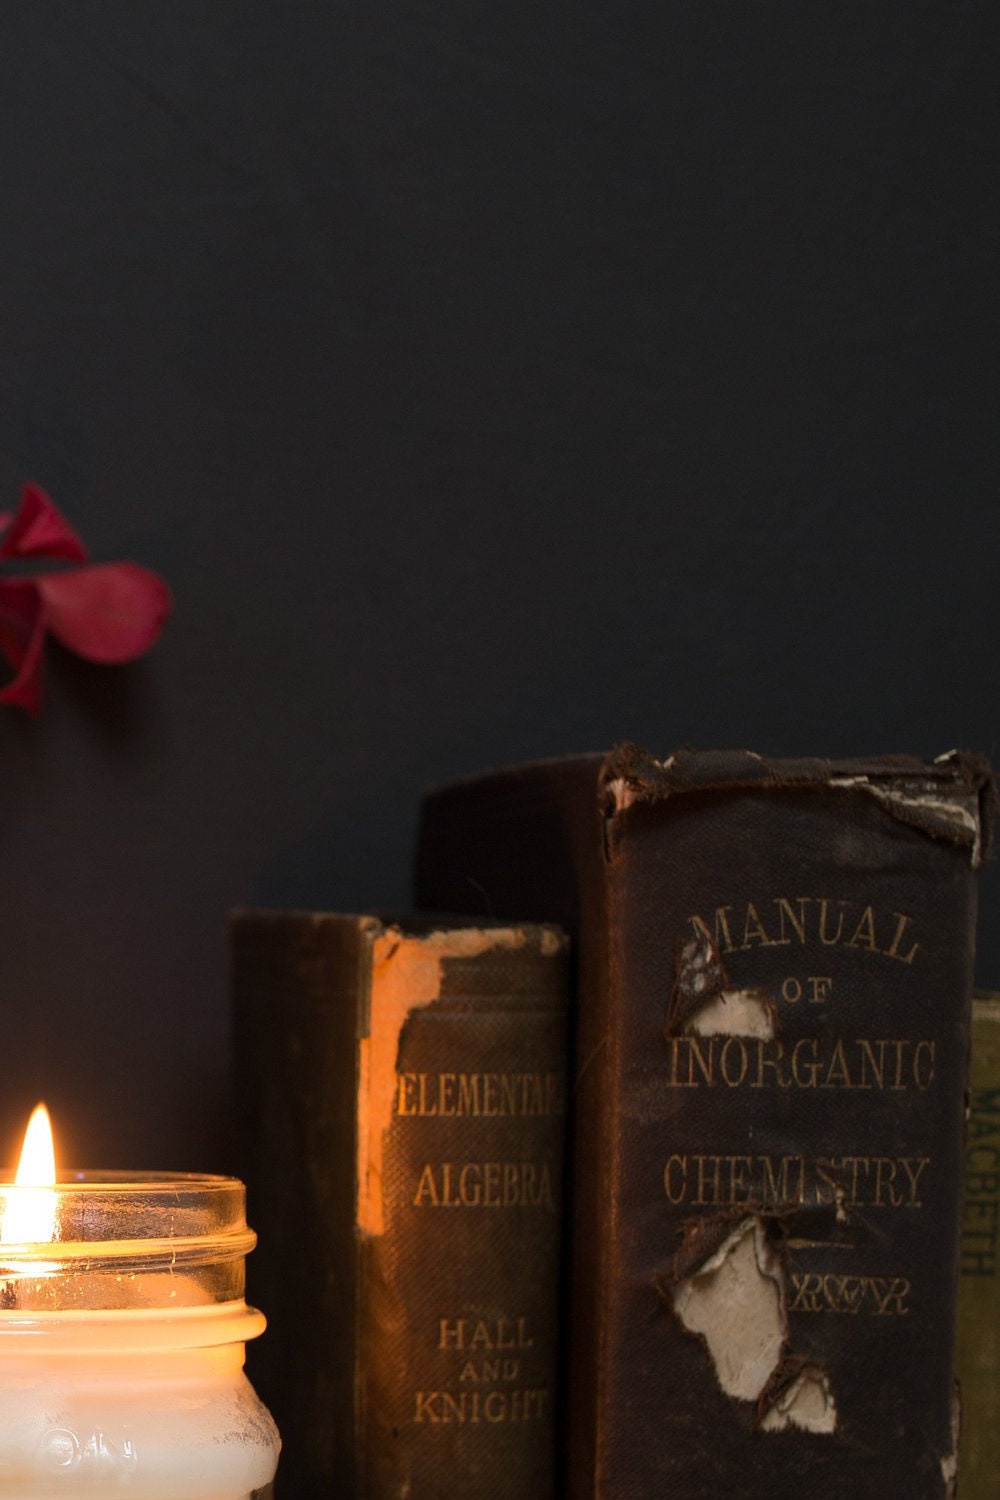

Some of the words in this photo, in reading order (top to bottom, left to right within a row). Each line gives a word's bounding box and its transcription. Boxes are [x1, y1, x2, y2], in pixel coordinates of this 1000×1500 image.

[687, 897, 920, 965] MANUAL
[781, 976, 832, 1004] OF
[667, 1036, 936, 1091] INORGANIC
[413, 1161, 557, 1207] ALGEBRA
[438, 1317, 534, 1350] HALL
[459, 1360, 520, 1382] AND
[413, 1389, 549, 1424] KNIGHT
